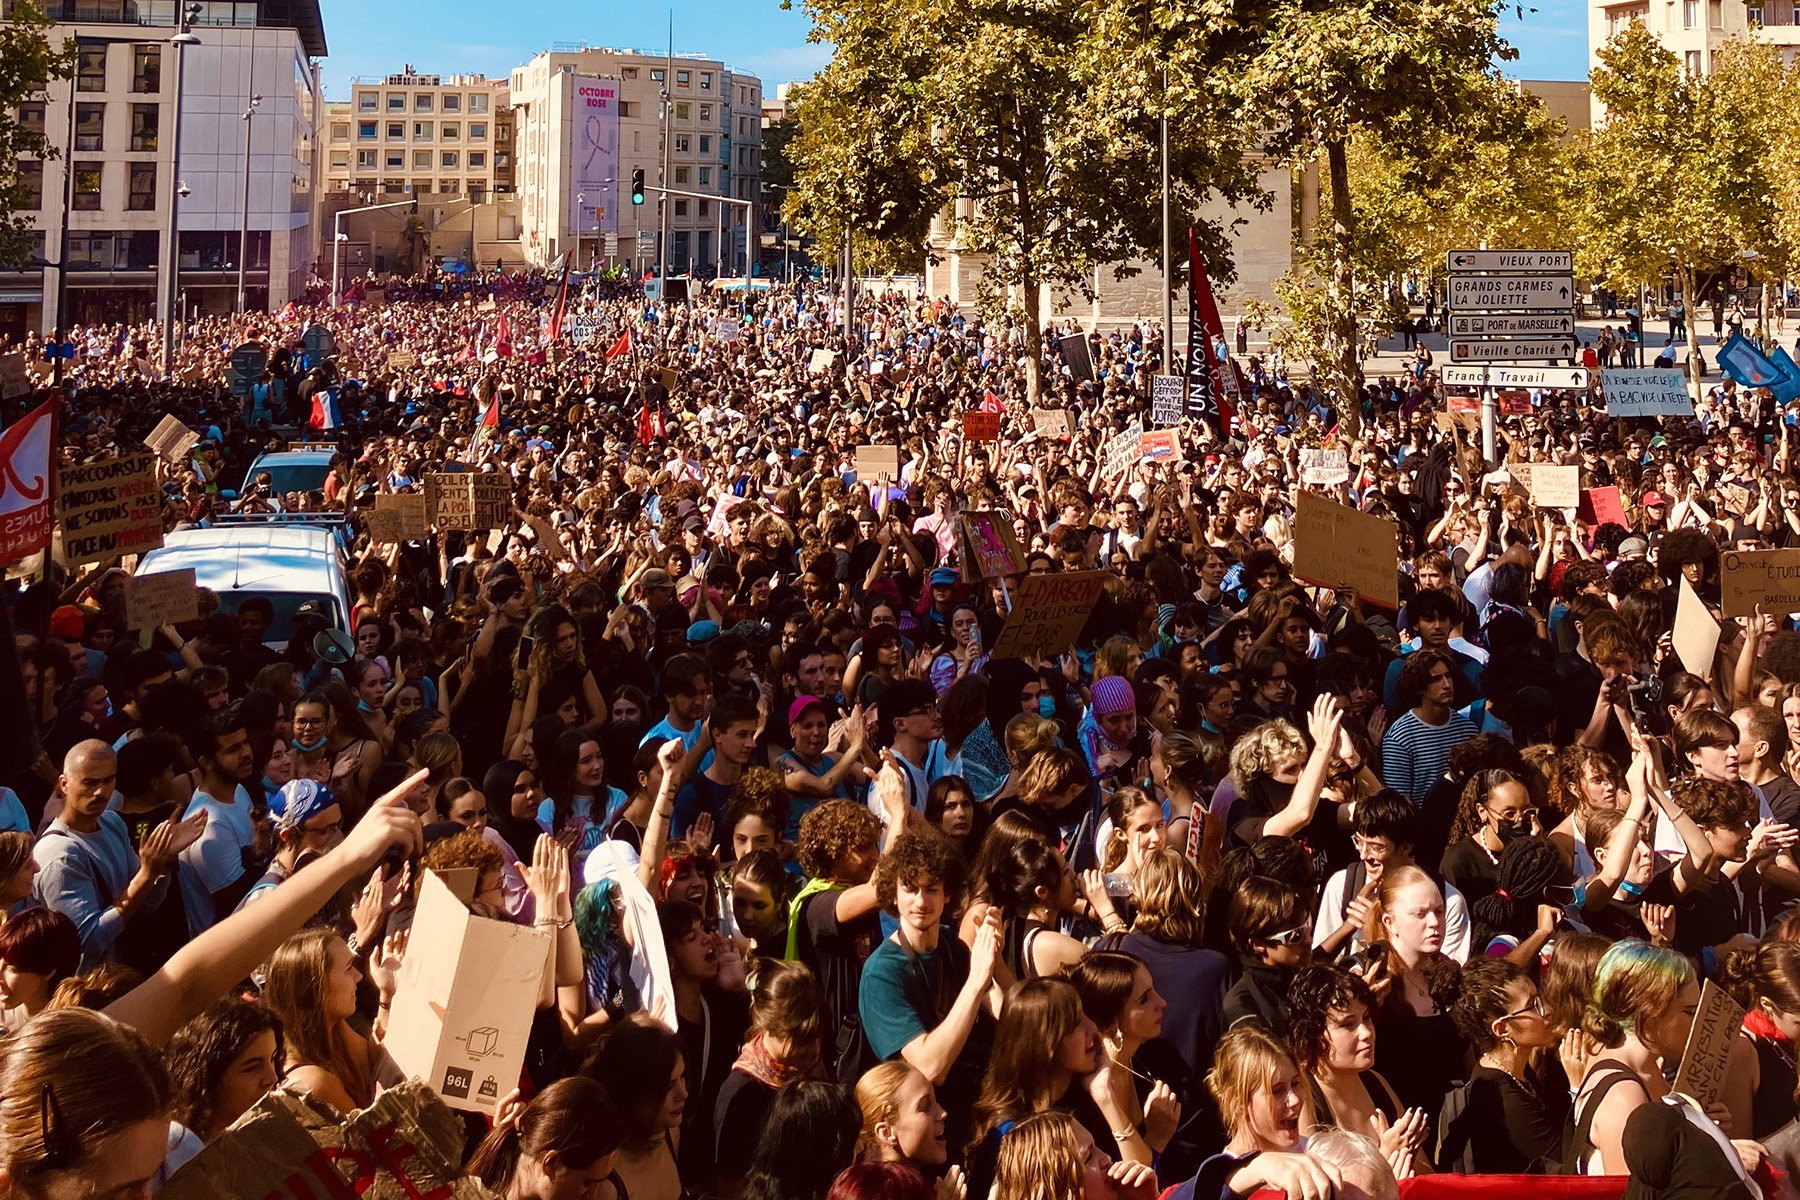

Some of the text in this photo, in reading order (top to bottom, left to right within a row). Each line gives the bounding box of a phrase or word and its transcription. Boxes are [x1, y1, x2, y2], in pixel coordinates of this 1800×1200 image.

[579, 86, 614, 98] OCTOBRE
[586, 98, 606, 108] ROSE
[1500, 256, 1568, 266] VIEUX PORT
[1454, 281, 1554, 292] GRANDS CARMES
[1455, 294, 1528, 305] LA JOLIETTE
[1488, 320, 1508, 330] PORT
[1518, 320, 1559, 330] MARSEILLE
[1473, 344, 1556, 356] Vieille Charité
[1448, 370, 1545, 382] France Travail
[1189, 384, 1205, 411] UN
[1605, 392, 1618, 403] LA
[1619, 391, 1641, 404] BAC
[460, 474, 483, 485] POUR
[136, 494, 156, 506] PAS
[436, 501, 448, 513] LA
[1023, 607, 1050, 624] POUR
[1686, 991, 1724, 1090] ARRESTATION
[447, 1075, 468, 1089] 96L
